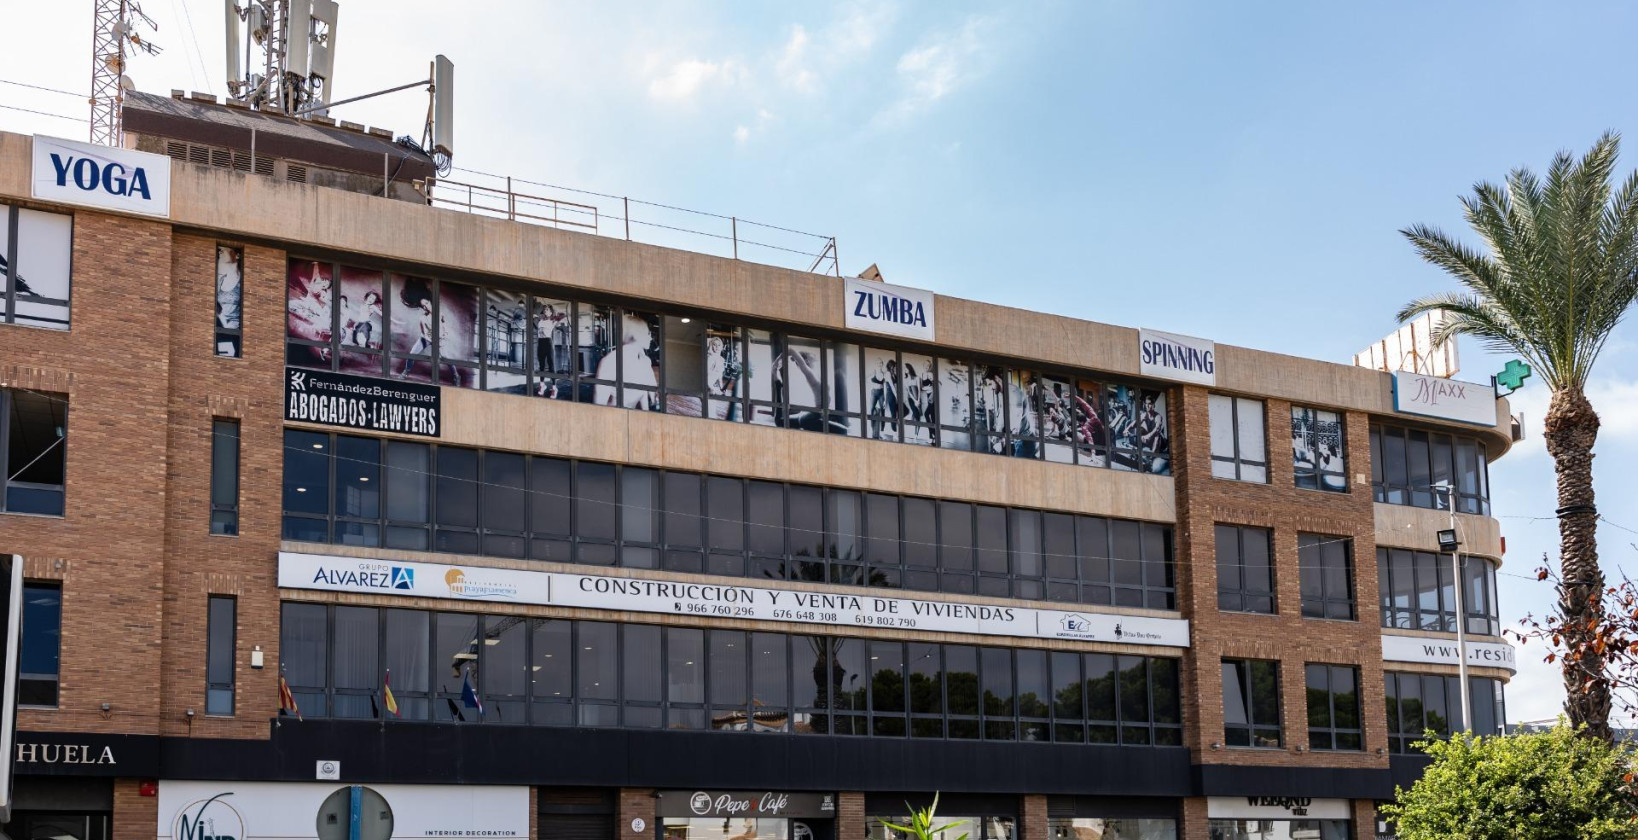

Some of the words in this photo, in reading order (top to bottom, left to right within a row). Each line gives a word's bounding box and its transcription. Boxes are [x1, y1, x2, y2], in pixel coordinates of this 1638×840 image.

[49, 152, 152, 201] YOGA
[854, 290, 927, 327] ZUMBA
[1142, 339, 1214, 374] SPINNING
[312, 566, 390, 588] ALVAREZ
[358, 563, 389, 572] GRUPO
[579, 577, 754, 604] CONSTRUCCIÓN
[768, 591, 781, 605] Y
[793, 593, 861, 610] VENTA
[874, 598, 899, 614] DE
[911, 601, 1015, 622] VIVIENDAS
[687, 603, 707, 613] 966
[711, 604, 731, 615] 760
[734, 606, 755, 616] 296
[773, 609, 792, 619] 676
[796, 610, 815, 621] 648
[819, 612, 837, 622] 308
[855, 614, 873, 625] 619
[877, 616, 895, 626] 802
[898, 618, 916, 628] 790
[758, 792, 788, 815] Café
